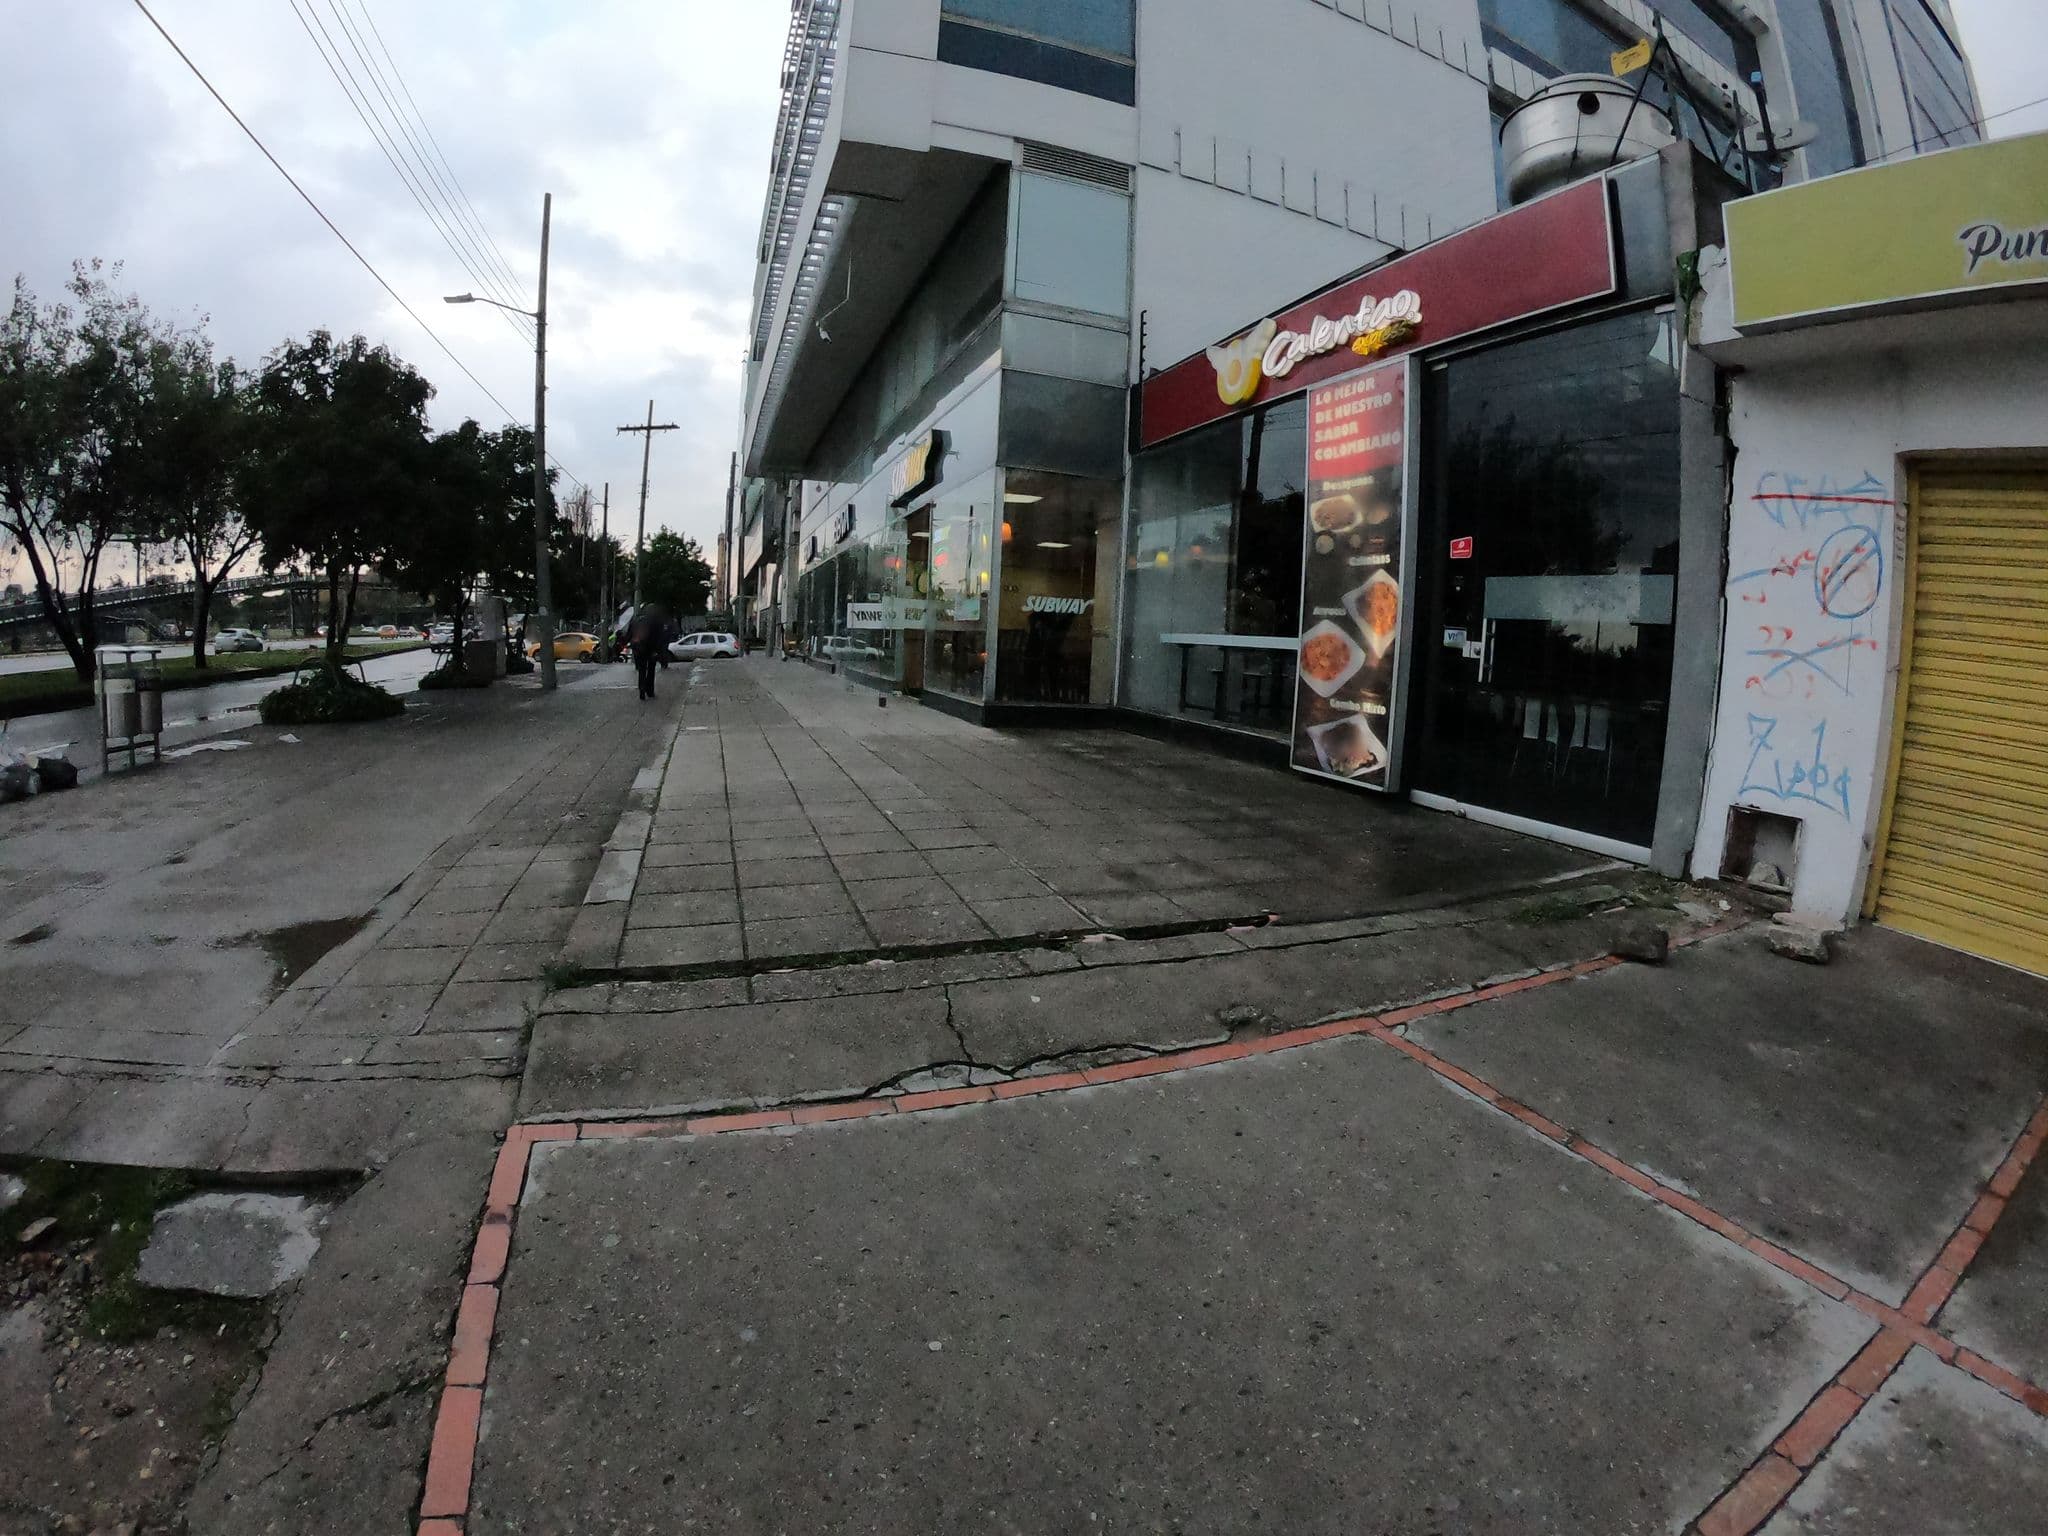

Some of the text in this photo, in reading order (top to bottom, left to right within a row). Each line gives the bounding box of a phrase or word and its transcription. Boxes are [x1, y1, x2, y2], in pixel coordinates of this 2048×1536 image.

[1262, 289, 1422, 377] Calentao
[1315, 377, 1376, 406] LO MEJOR
[1315, 392, 1393, 424] DE NUESTRO
[1314, 421, 1359, 442] SABOR
[1314, 431, 1401, 461] COLOMBIANO
[1022, 595, 1094, 614] SUBWAY
